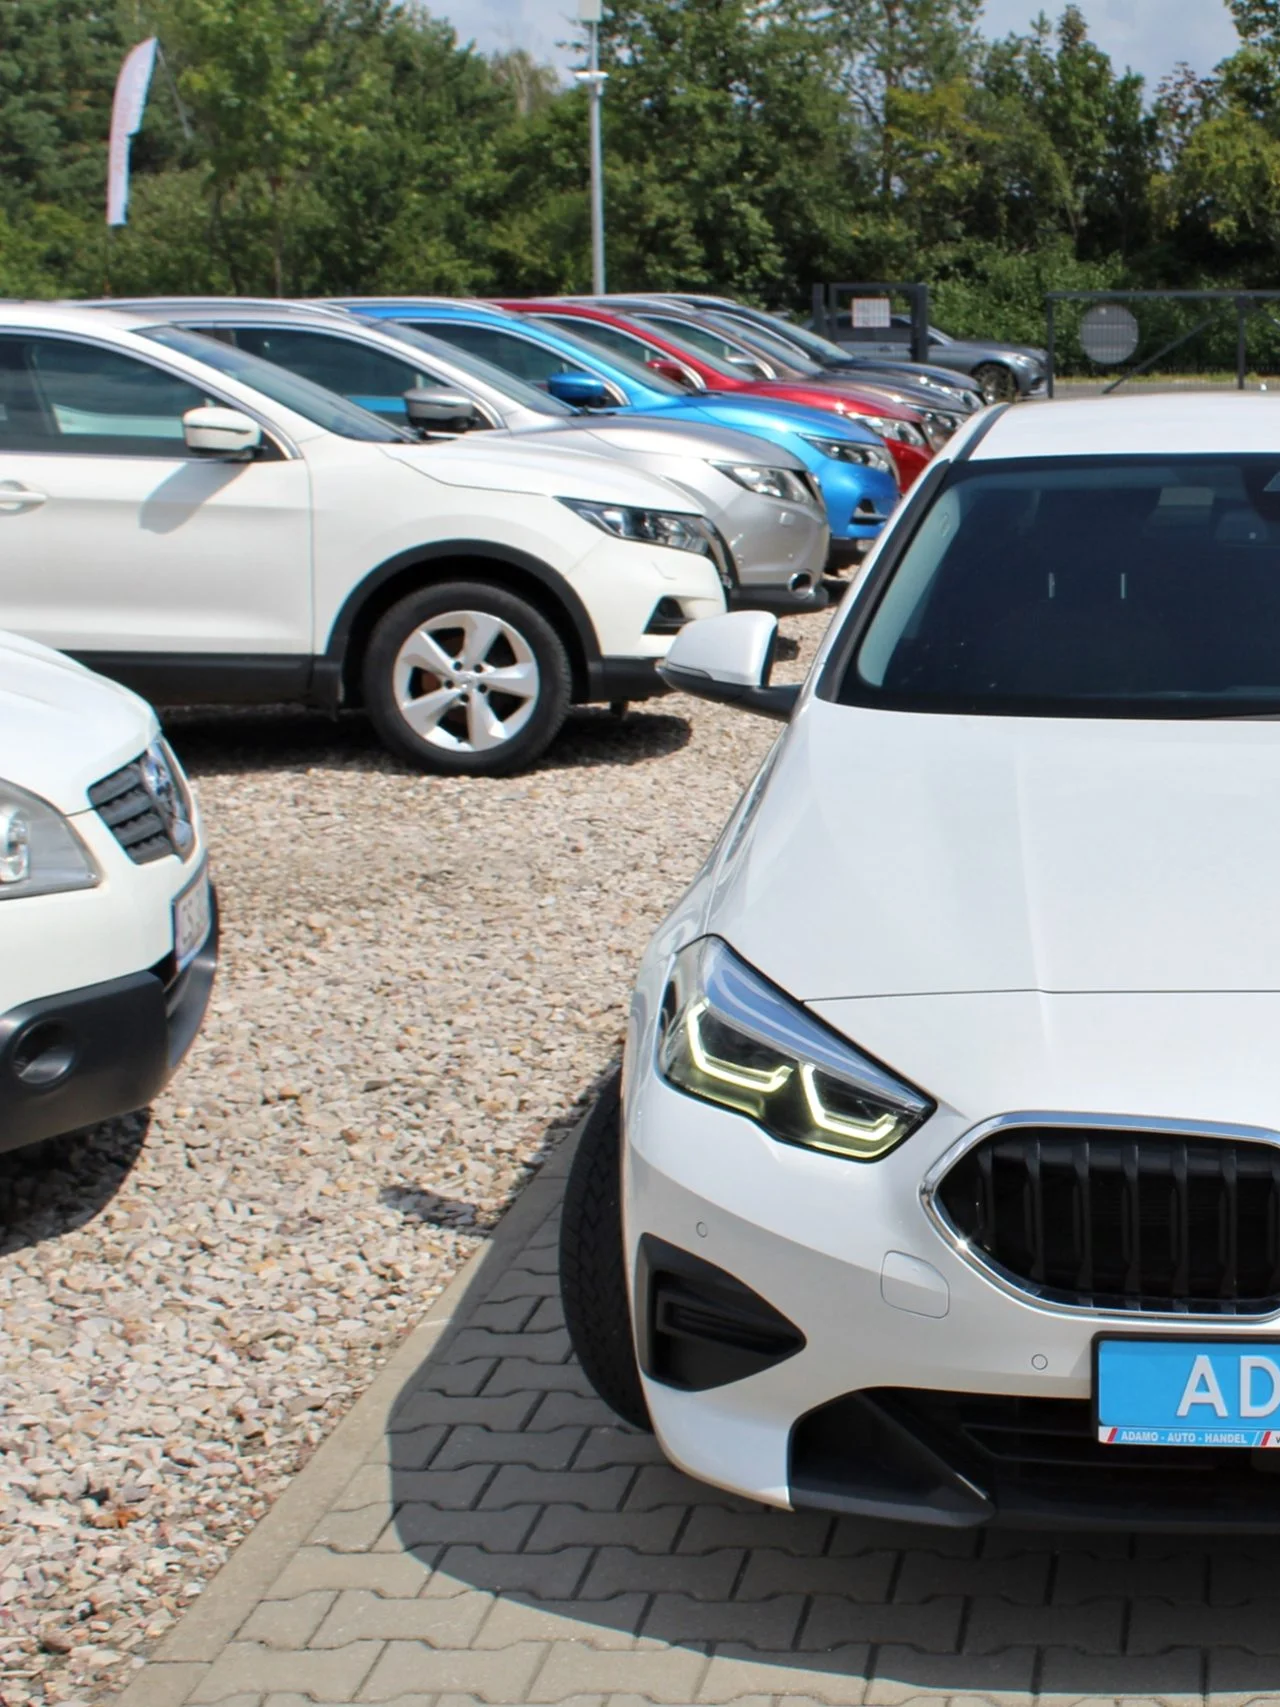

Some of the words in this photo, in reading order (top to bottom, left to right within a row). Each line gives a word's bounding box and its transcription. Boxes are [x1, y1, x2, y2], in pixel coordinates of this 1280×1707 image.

[1121, 1431, 1159, 1442] ADAMO
[1167, 1432, 1196, 1443] AUTO
[1204, 1433, 1248, 1444] HANDEL
